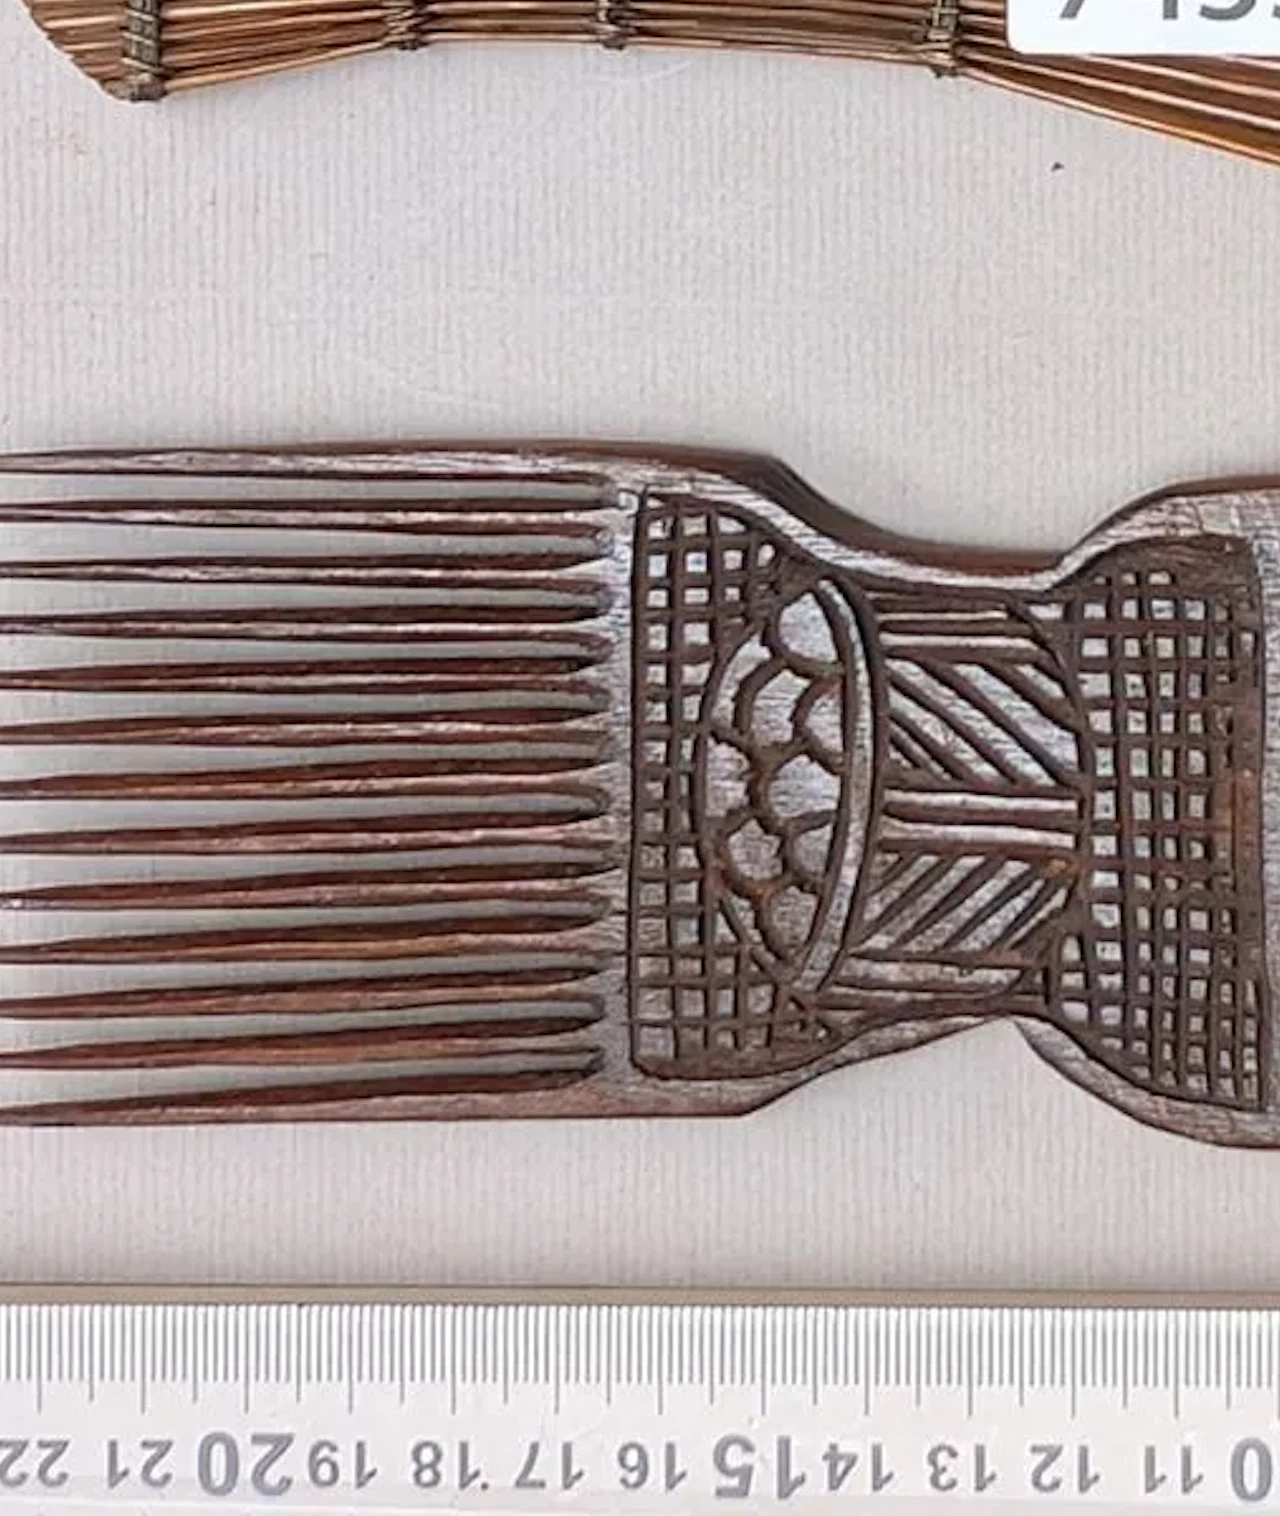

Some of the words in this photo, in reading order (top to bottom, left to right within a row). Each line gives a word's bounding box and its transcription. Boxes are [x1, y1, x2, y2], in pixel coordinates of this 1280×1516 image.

[105, 1439, 175, 1488] 21
[197, 1431, 296, 1497] 20
[307, 1440, 378, 1490] 19
[410, 1440, 482, 1491] 18
[514, 1441, 584, 1491] 17
[619, 1441, 687, 1492] 16
[712, 1434, 807, 1501] 15
[821, 1441, 894, 1492] 14
[926, 1443, 997, 1493] 13
[1028, 1444, 1101, 1494] 12
[1142, 1444, 1204, 1495] 11
